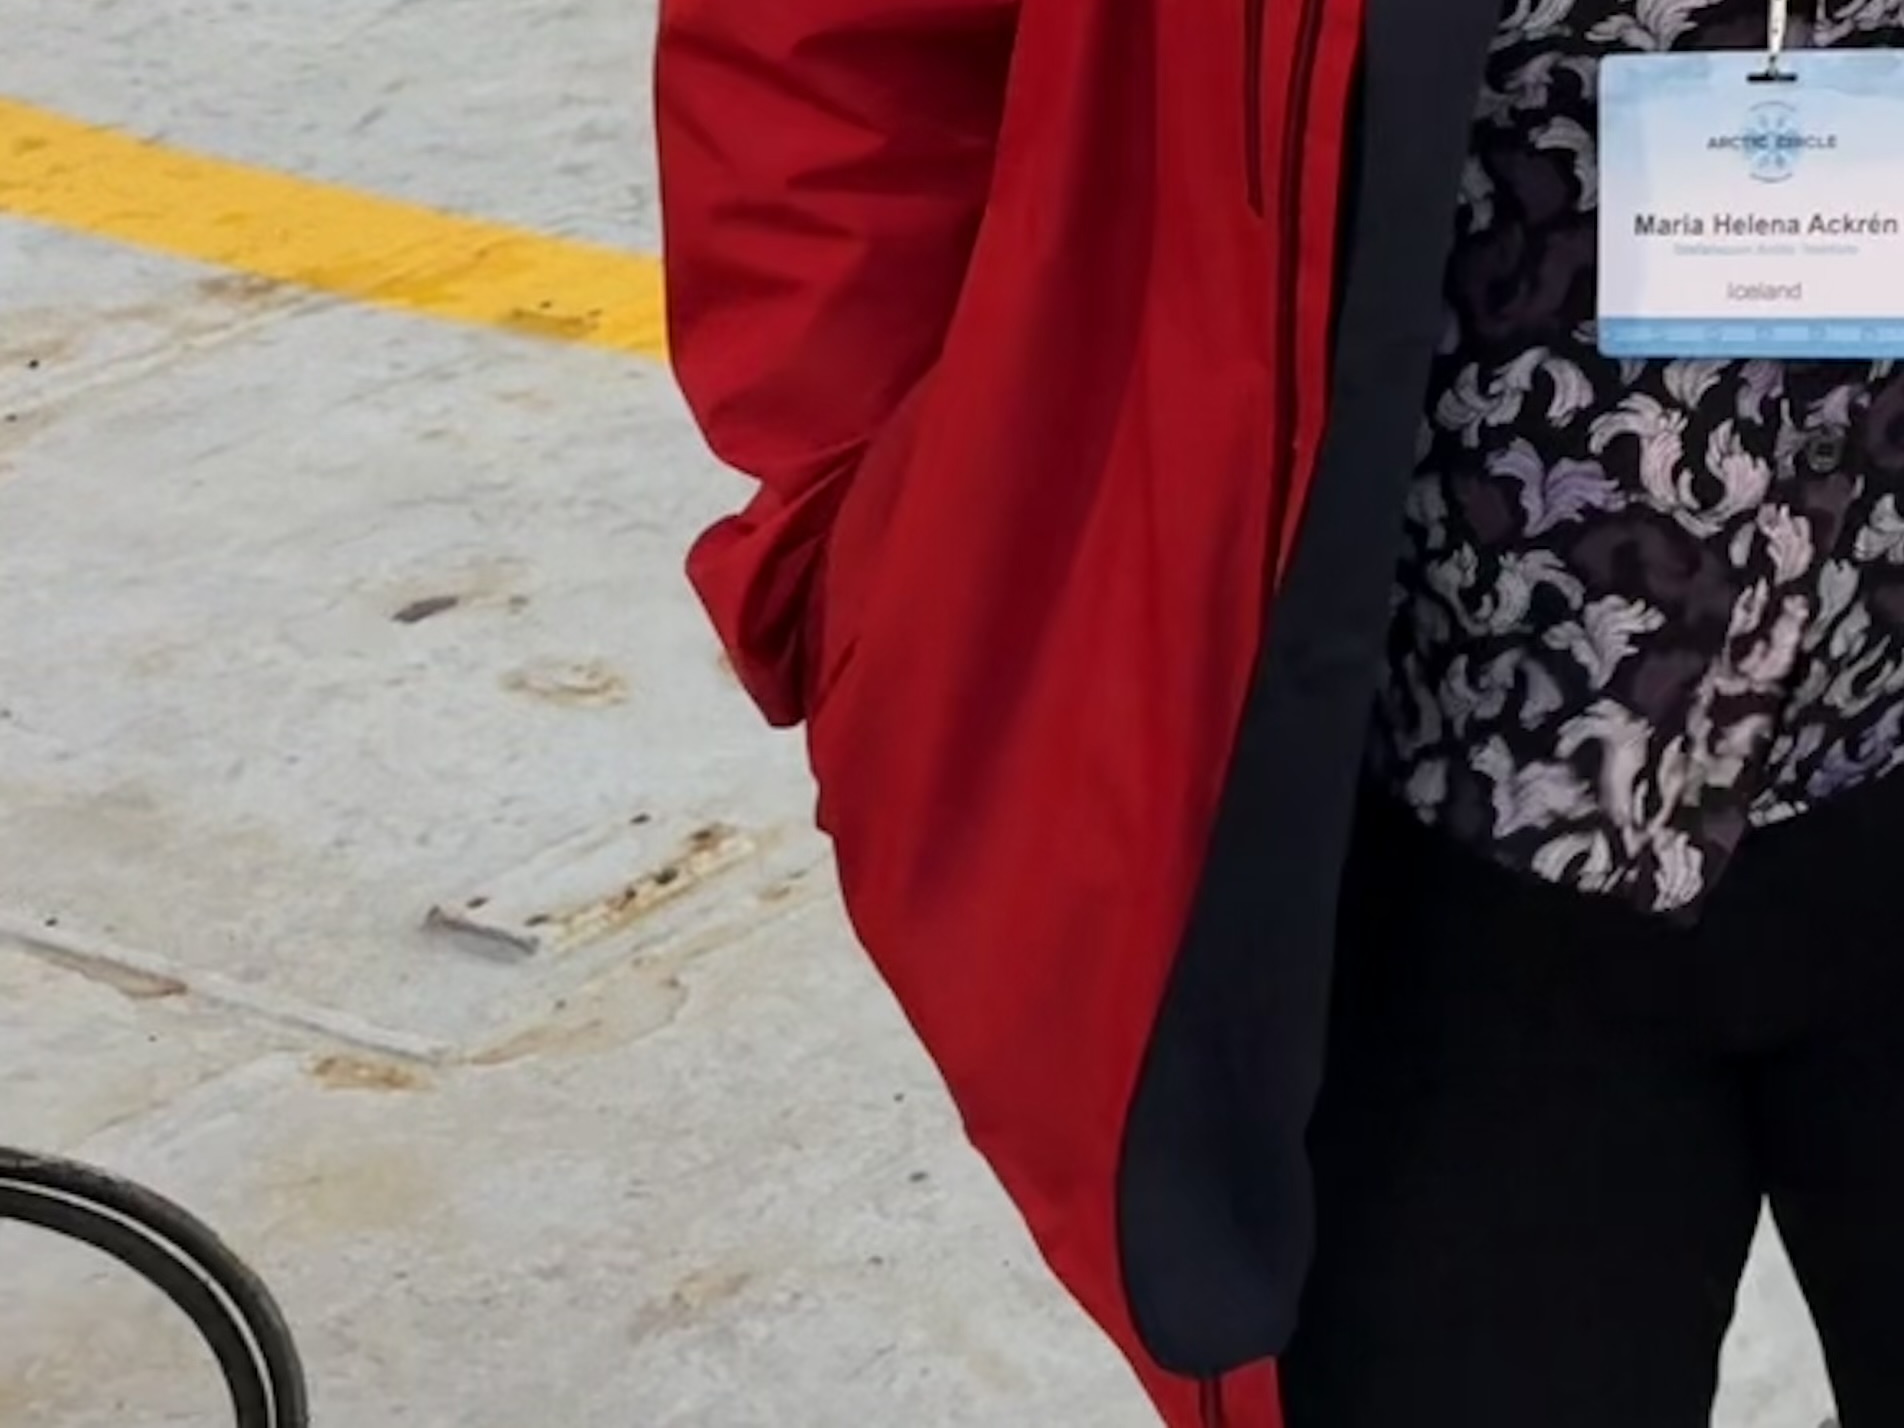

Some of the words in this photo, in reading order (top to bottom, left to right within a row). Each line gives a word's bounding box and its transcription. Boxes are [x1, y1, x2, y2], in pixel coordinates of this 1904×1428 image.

[1707, 135, 1768, 150] ARCTIC
[1713, 213, 1800, 236] Helena
[1808, 212, 1899, 236] Ackrén
[1727, 281, 1802, 301] Iceland
